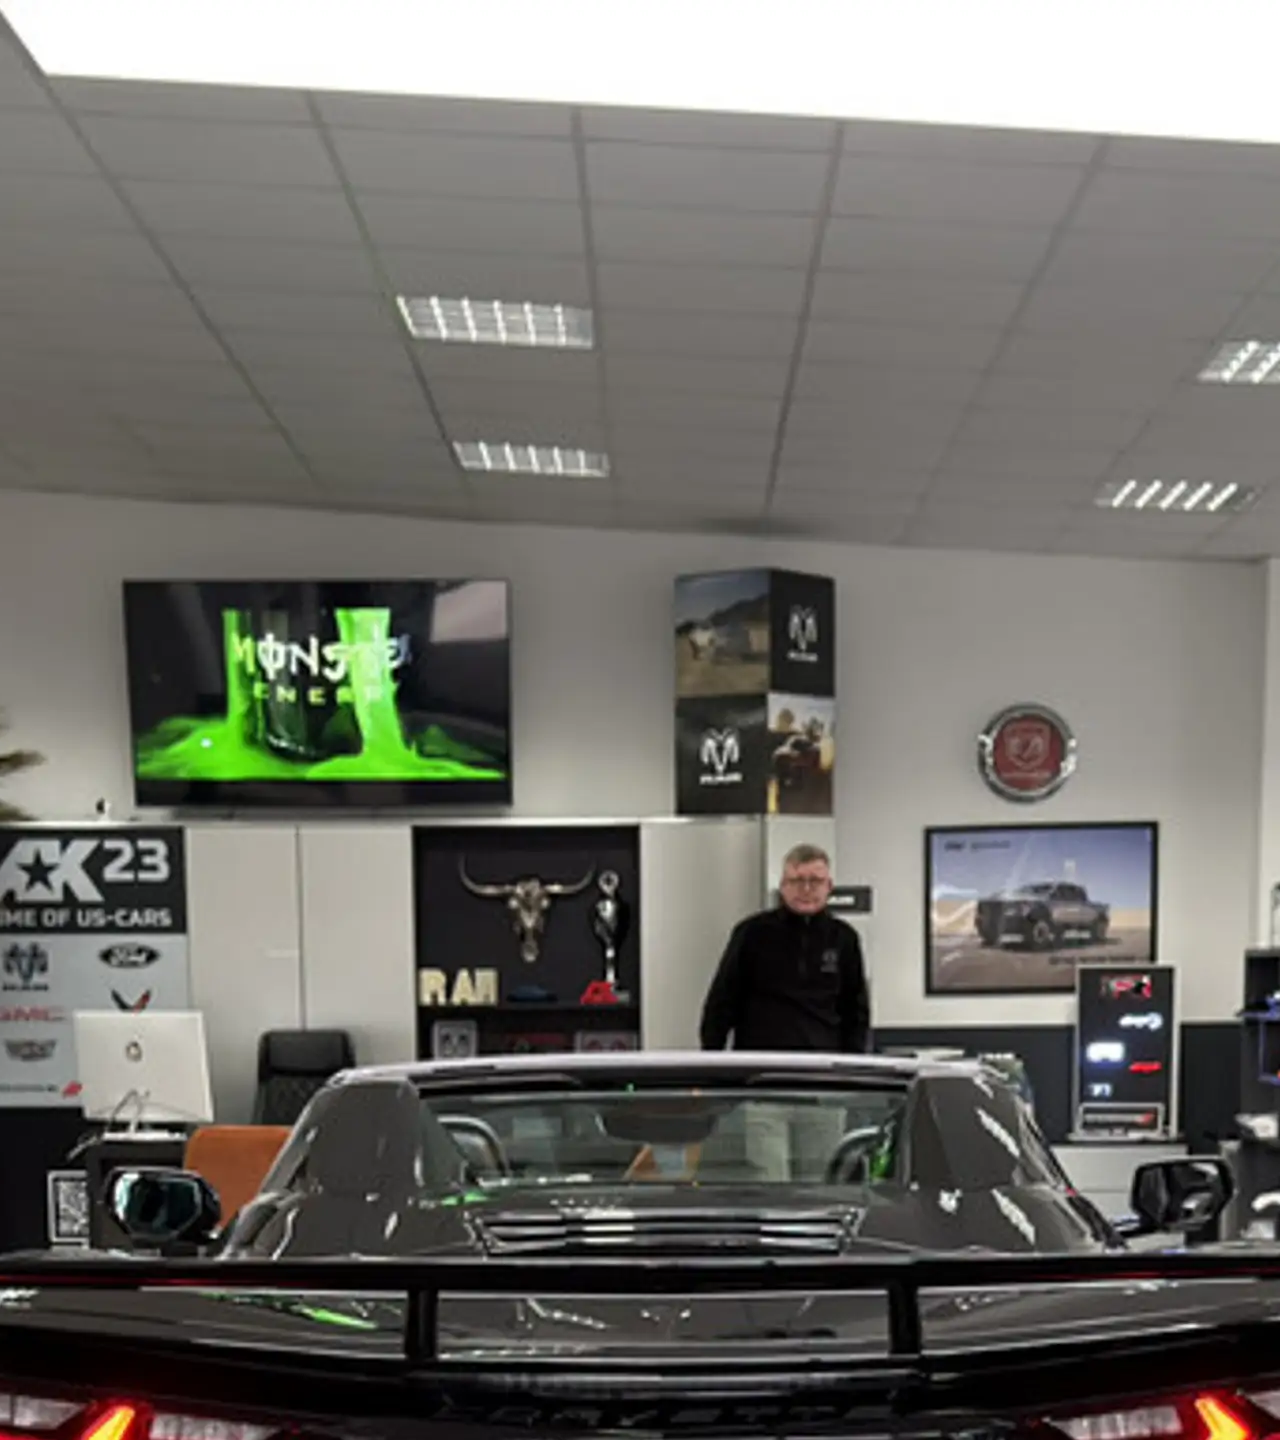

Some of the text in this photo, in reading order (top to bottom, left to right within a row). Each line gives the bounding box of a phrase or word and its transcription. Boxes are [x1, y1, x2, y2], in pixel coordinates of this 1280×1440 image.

[231, 633, 412, 682] MONSE
[41, 908, 70, 928] OF
[76, 907, 172, 928] US-CARS
